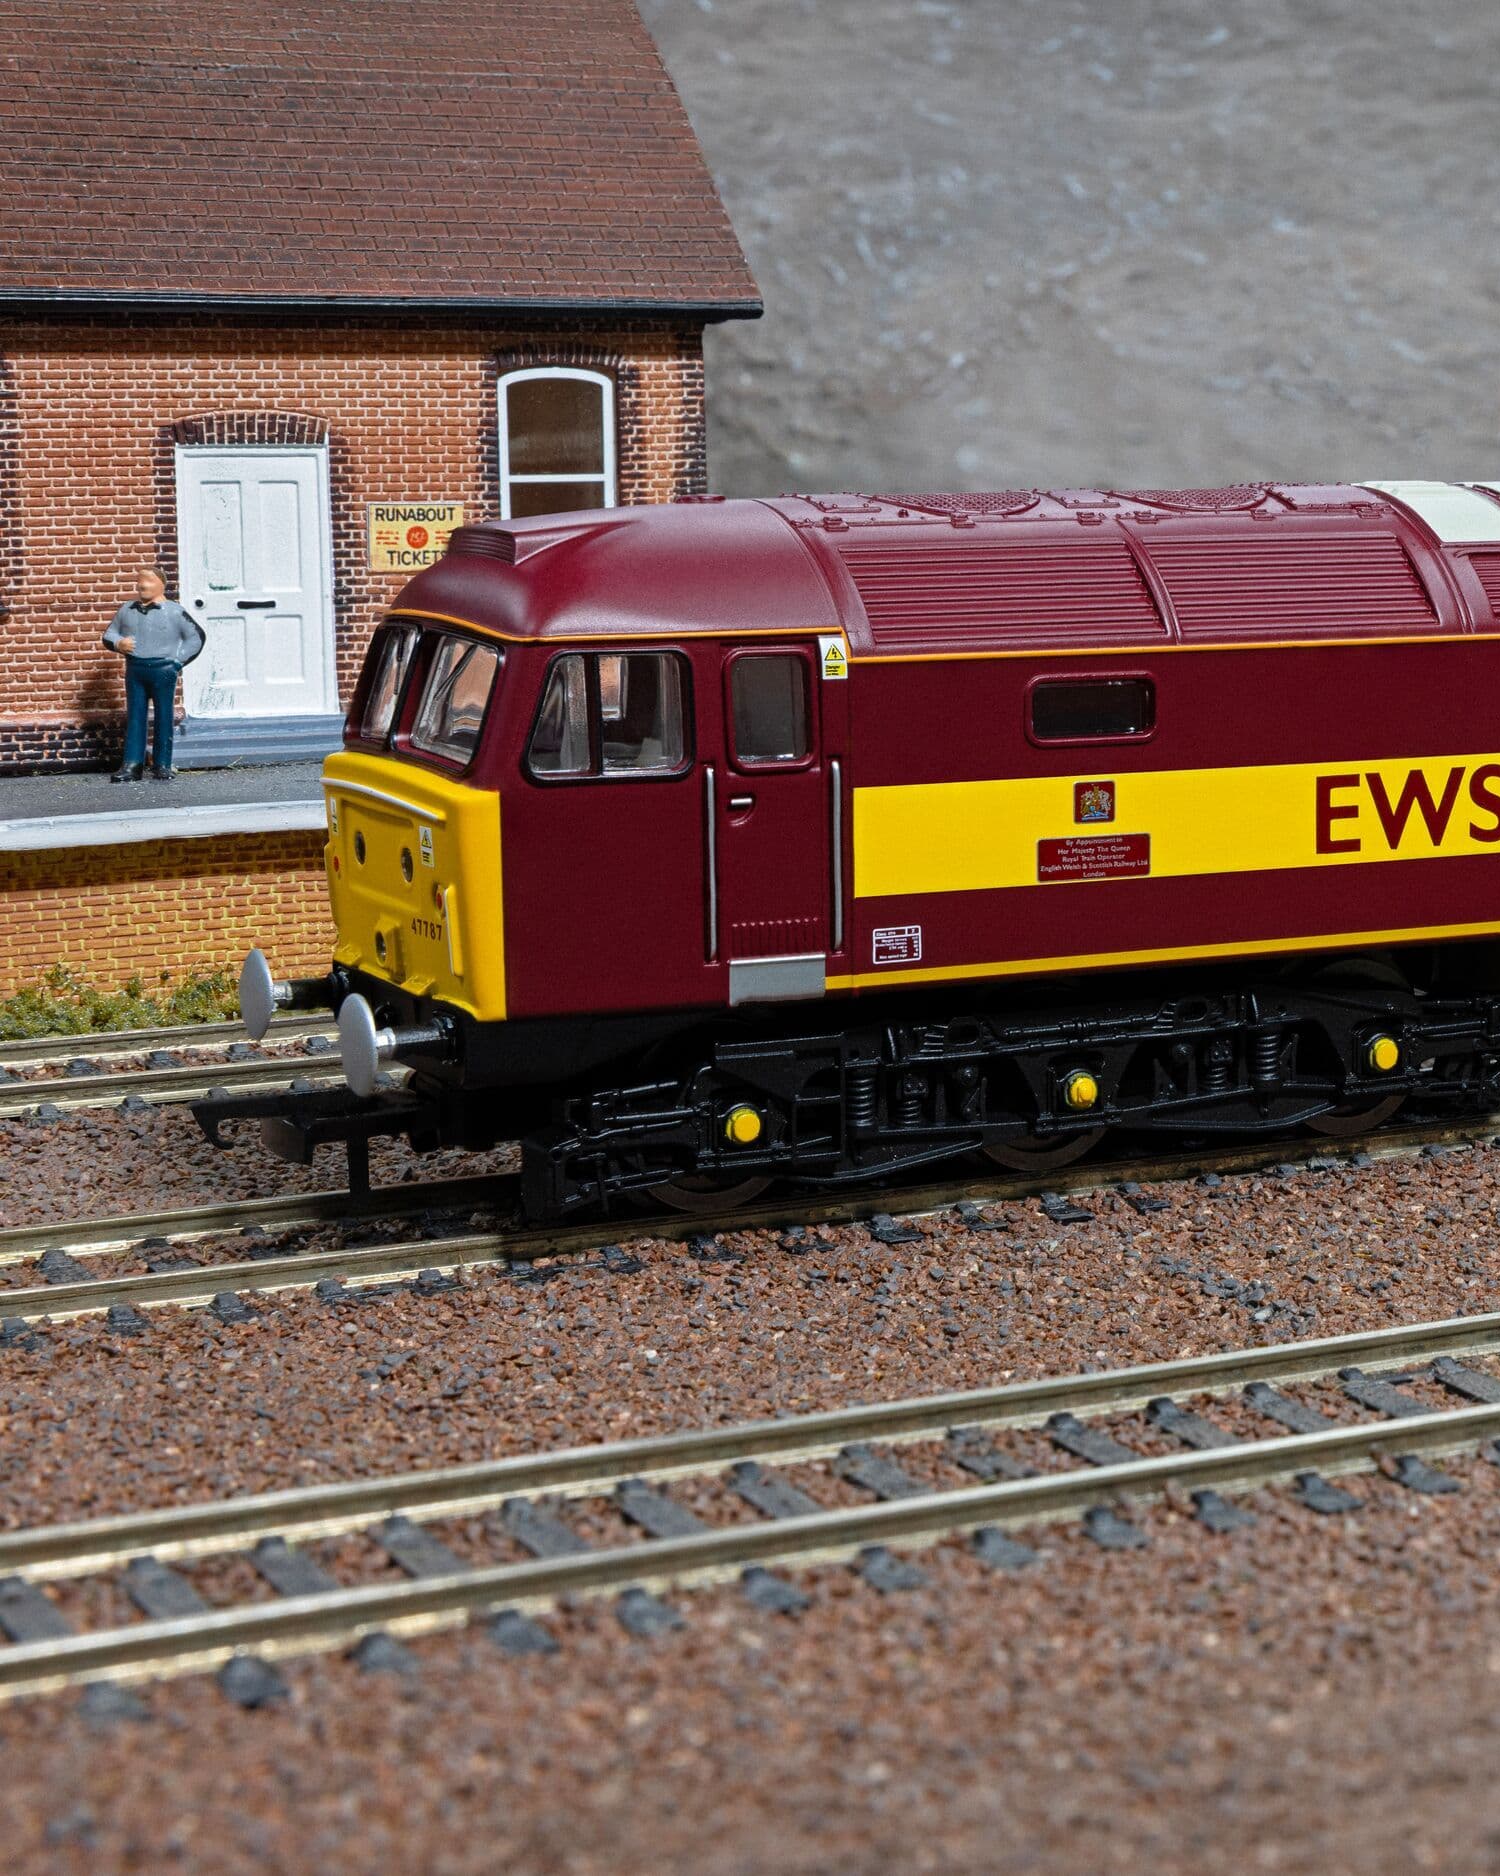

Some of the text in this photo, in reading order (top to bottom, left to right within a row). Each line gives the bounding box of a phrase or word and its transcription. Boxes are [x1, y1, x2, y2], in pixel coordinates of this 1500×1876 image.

[375, 507, 455, 521] RUNABOUT
[1071, 847, 1095, 855] Majesty
[411, 918, 442, 941] 47787
